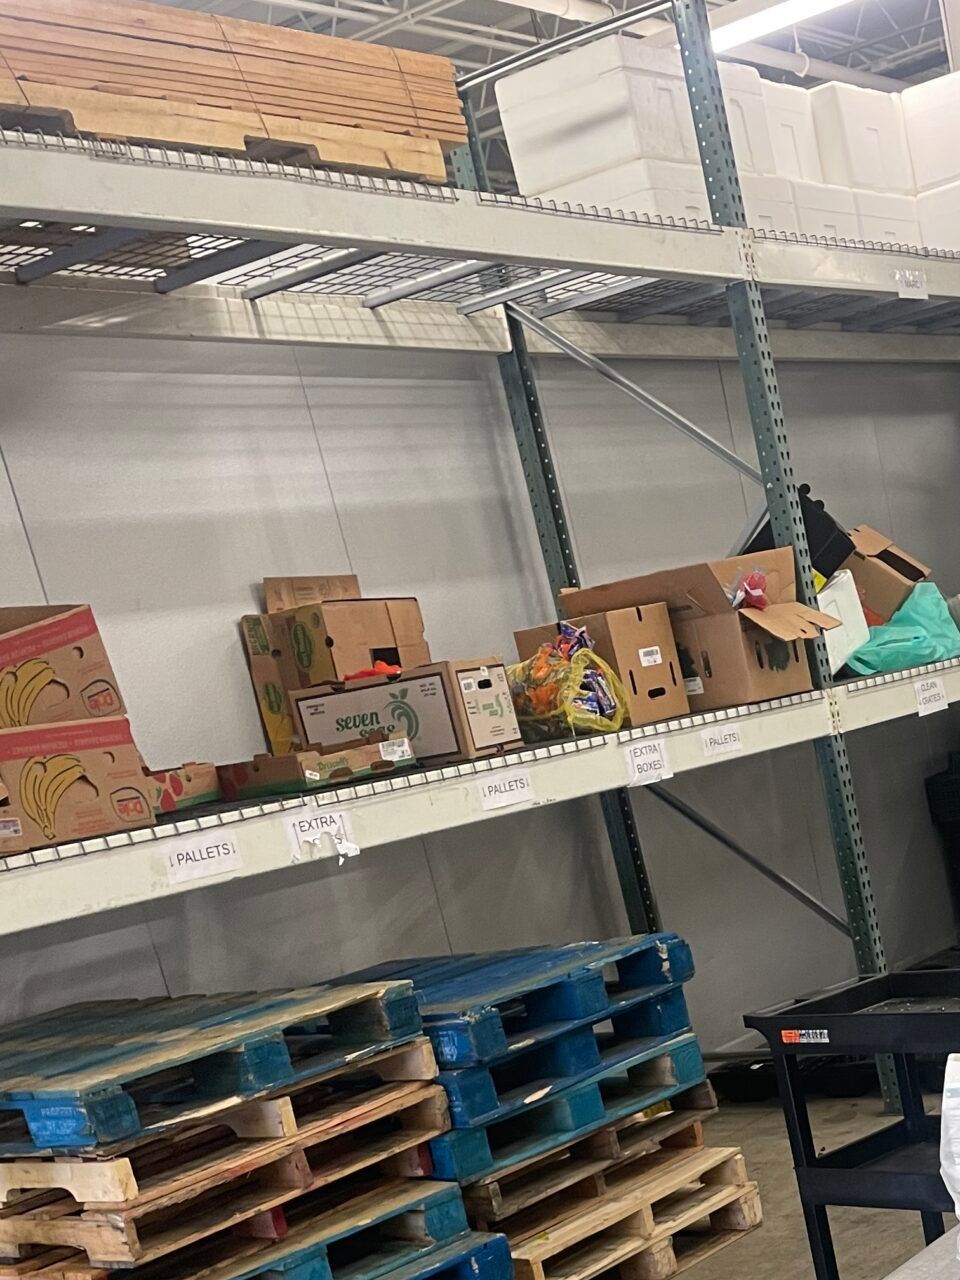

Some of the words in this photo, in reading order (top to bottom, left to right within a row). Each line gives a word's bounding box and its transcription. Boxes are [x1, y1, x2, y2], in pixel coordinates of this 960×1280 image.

[335, 711, 381, 732] seven
[709, 731, 737, 748] PALLETS
[633, 746, 659, 758] EXTRA
[636, 759, 663, 774] BOXES
[487, 778, 526, 796] PALLETS
[299, 815, 337, 833] EXTRA
[176, 842, 231, 866] PALLETS
